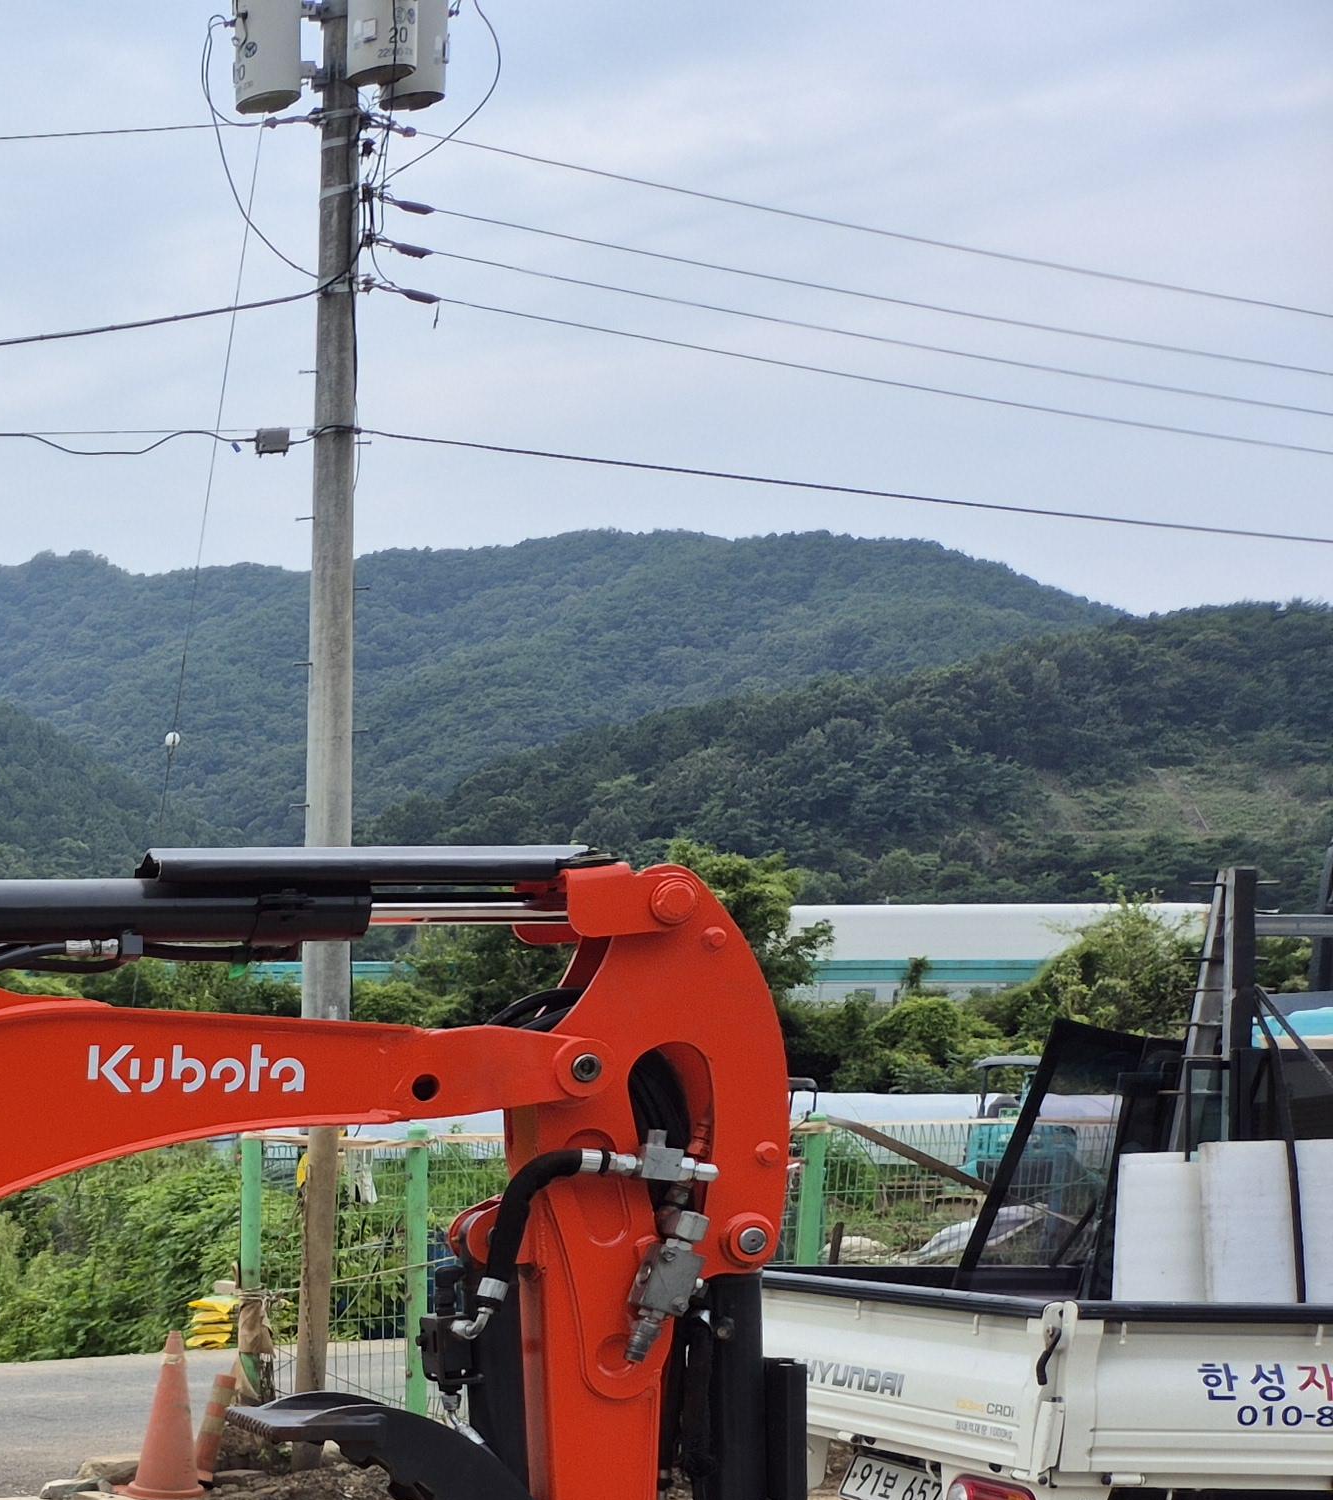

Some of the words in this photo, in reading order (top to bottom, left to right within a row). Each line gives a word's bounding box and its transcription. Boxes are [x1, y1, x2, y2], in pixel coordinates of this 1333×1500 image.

[388, 26, 408, 43] 20
[87, 1044, 306, 1093] Kubota
[806, 1358, 906, 1398] HYUNDAI
[1237, 1405, 1333, 1427] 010-8
[855, 1463, 899, 1499] 91보
